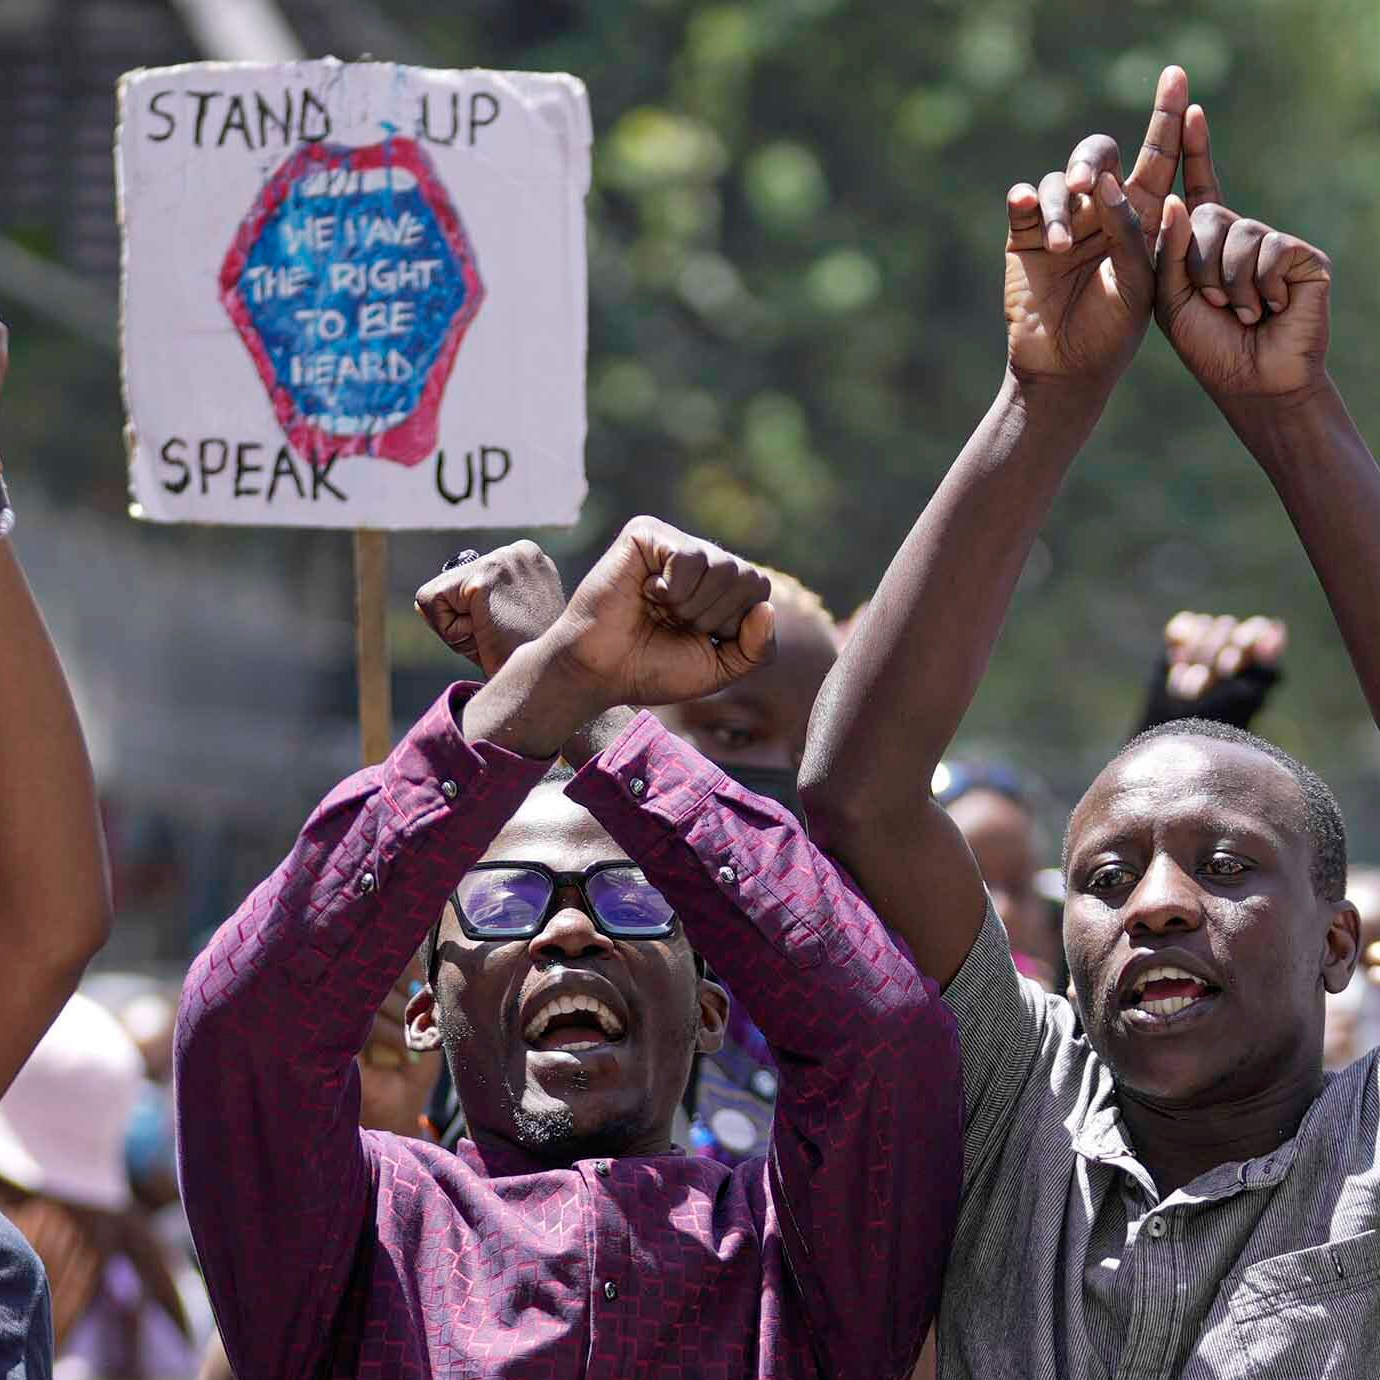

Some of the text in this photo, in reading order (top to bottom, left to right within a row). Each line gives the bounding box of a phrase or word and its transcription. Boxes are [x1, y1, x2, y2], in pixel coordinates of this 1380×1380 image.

[146, 88, 500, 149] STAND UP
[281, 212, 425, 255] WE HAVE
[247, 258, 444, 304] THE RIGHT
[295, 300, 417, 343] TO BE
[289, 348, 416, 386] HEARD
[161, 437, 512, 508] SPEAK UP
